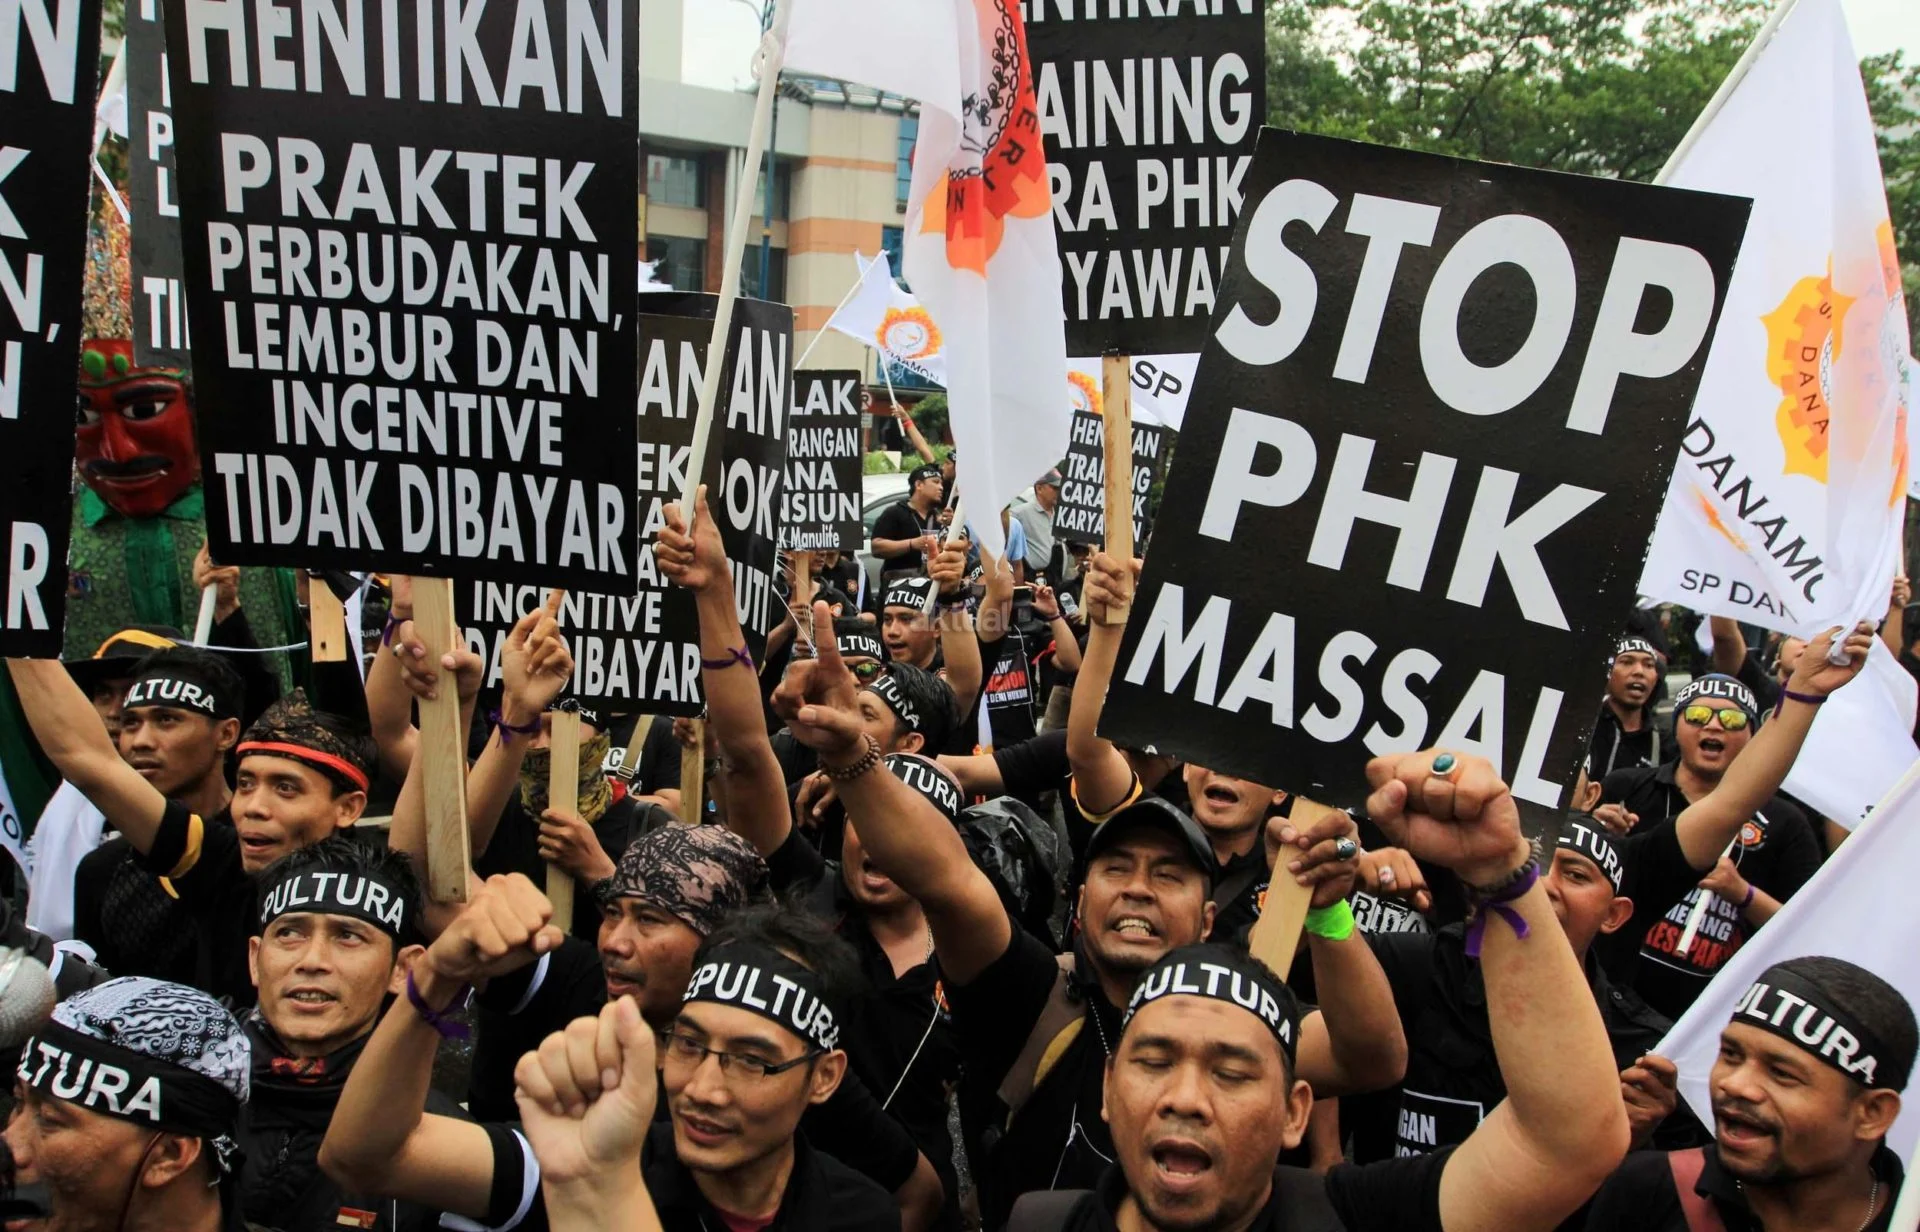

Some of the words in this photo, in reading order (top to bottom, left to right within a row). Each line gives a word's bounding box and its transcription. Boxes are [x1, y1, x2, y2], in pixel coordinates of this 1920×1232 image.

[220, 132, 599, 242] PRAKTEK
[1137, 155, 1252, 230] PHK
[206, 222, 624, 332] PERBUDAKAN,
[1214, 178, 1717, 436] STOP
[223, 301, 455, 383] LEMBUR
[475, 318, 600, 398] DAN
[1130, 360, 1183, 398] SP
[272, 379, 564, 467] INCENTIVE
[214, 453, 385, 552] TIDAK
[398, 463, 629, 576] DIBAYAR
[790, 523, 840, 549] Manulife
[1198, 406, 1607, 631] PHK
[1680, 569, 1721, 594] SP
[1123, 582, 1565, 810] MASSAL
[260, 871, 405, 934] PULTURA
